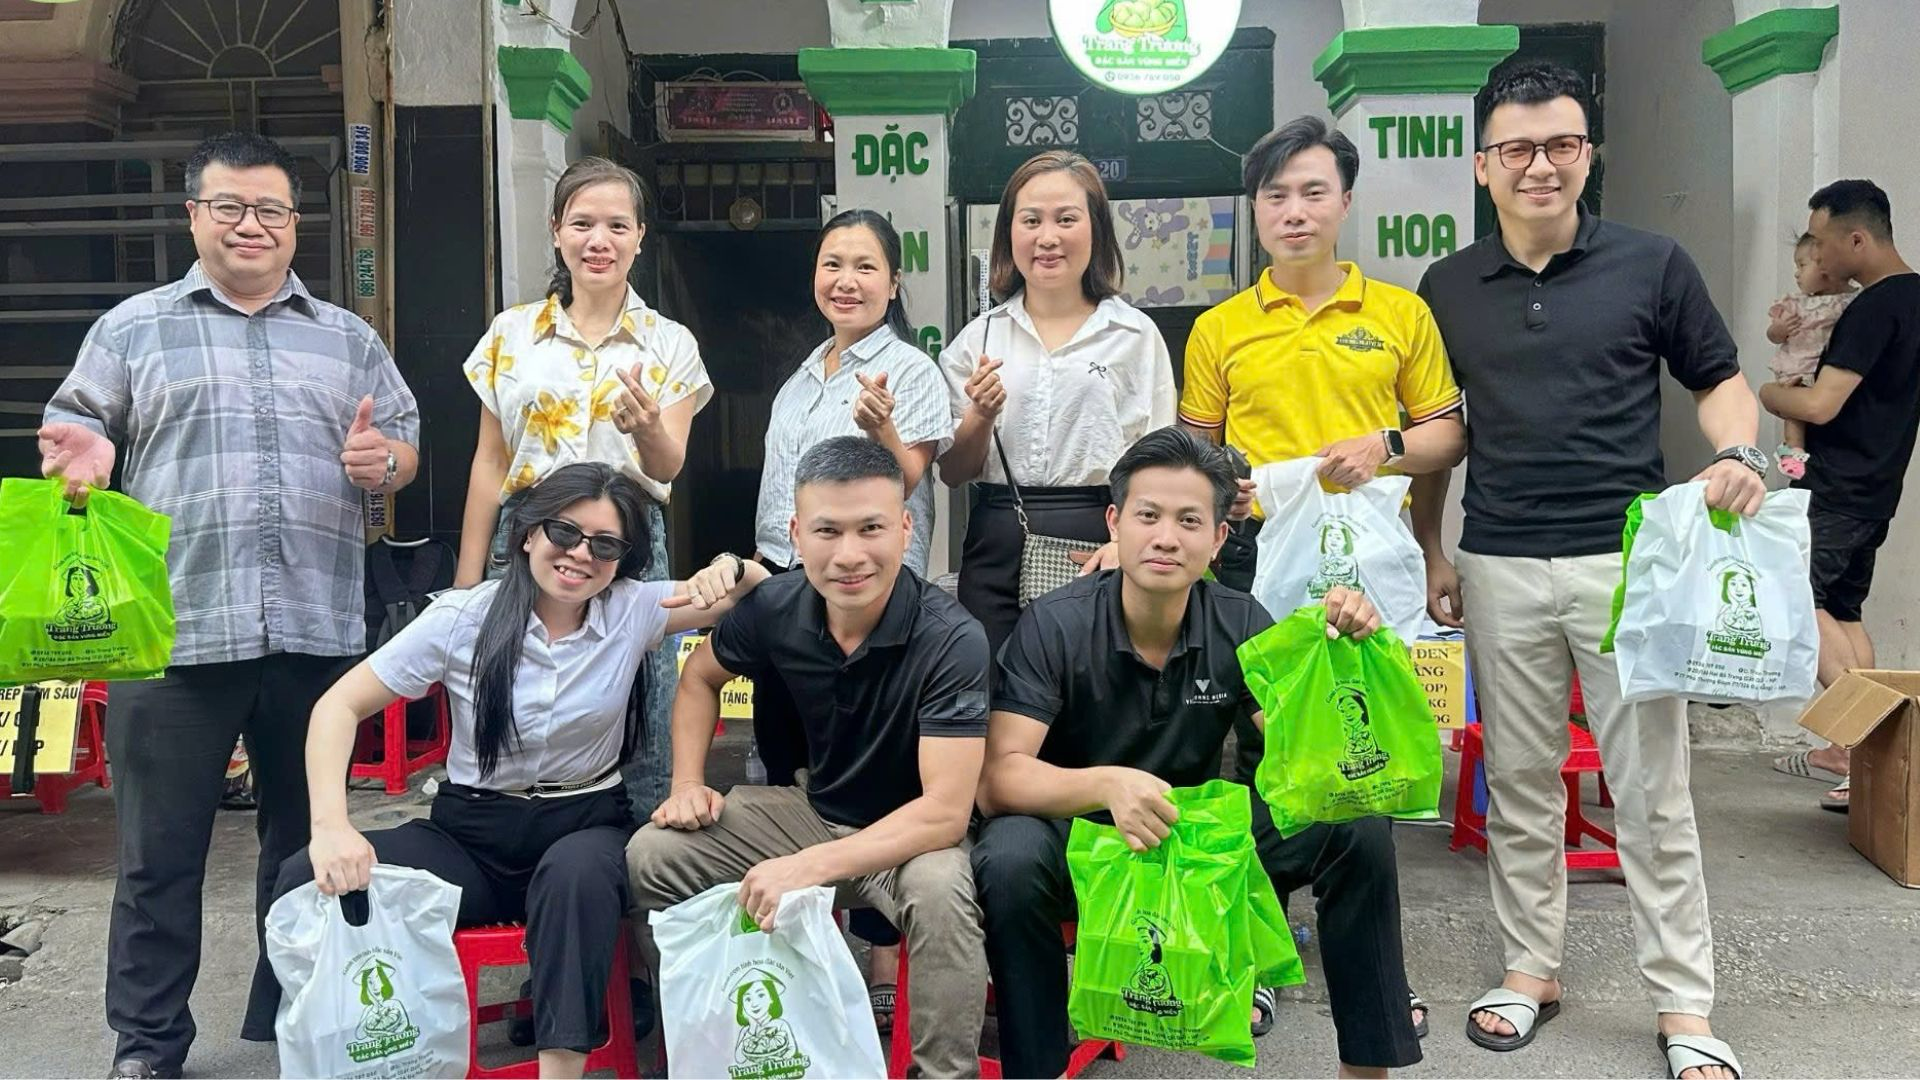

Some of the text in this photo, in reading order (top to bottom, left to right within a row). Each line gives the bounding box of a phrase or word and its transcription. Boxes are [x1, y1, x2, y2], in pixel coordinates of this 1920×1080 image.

[852, 123, 930, 183] ĐẶC
[1369, 115, 1463, 159] TINH
[1100, 161, 1120, 179] 20
[1378, 213, 1457, 258] HOA
[346, 1040, 383, 1053] Trang
[728, 1055, 811, 1078] Trang Trương
